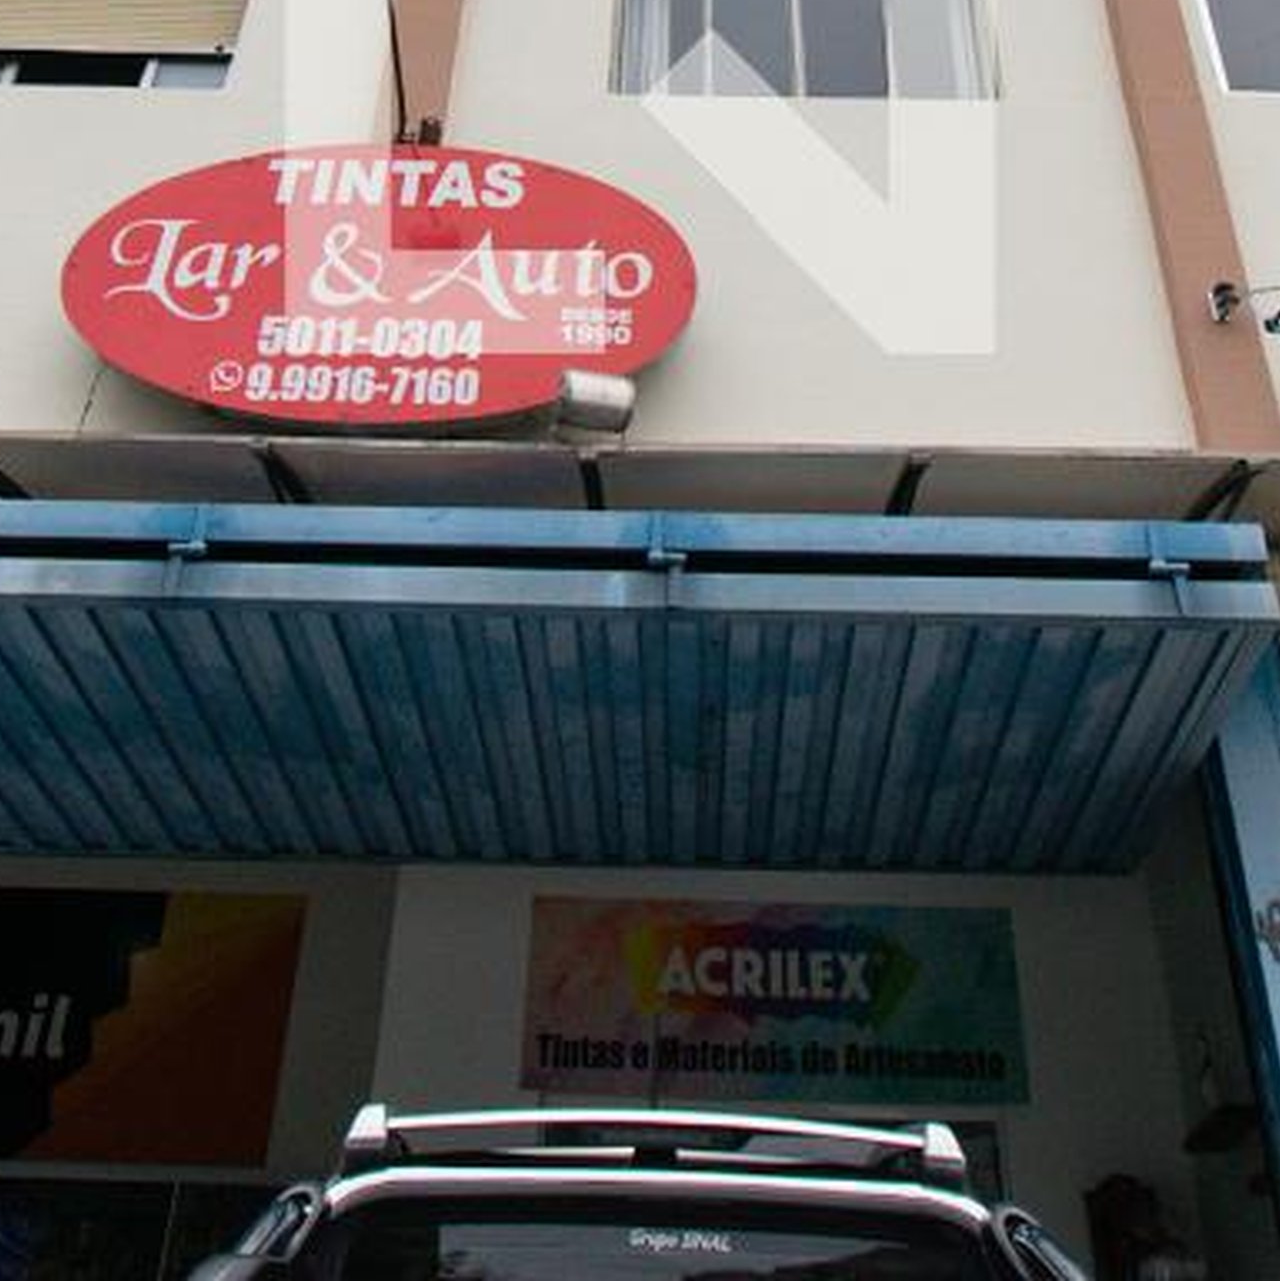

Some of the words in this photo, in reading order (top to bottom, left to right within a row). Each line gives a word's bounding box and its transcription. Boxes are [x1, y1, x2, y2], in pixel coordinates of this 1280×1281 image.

[269, 159, 526, 209] TINTAS
[103, 219, 281, 321] Lar
[309, 222, 393, 306] &
[408, 229, 655, 321] Auto
[257, 316, 483, 358] 5011-0304
[245, 363, 481, 405] 9.9916-7160
[656, 946, 872, 1002] ACRILEX
[536, 1032, 624, 1070] Tintas
[630, 1042, 649, 1071] e
[657, 1034, 796, 1076] Materiais
[801, 1041, 838, 1077] de
